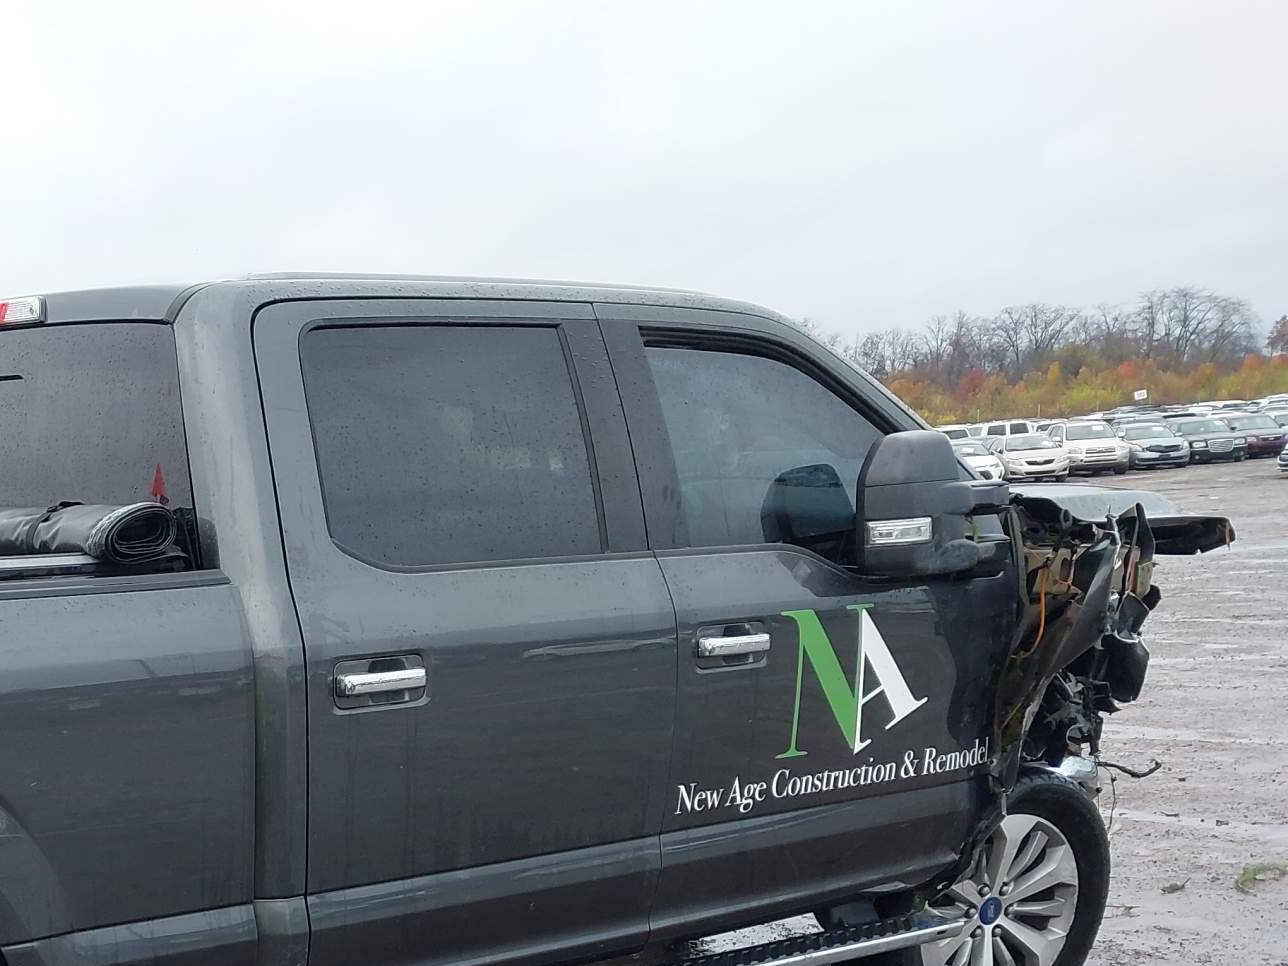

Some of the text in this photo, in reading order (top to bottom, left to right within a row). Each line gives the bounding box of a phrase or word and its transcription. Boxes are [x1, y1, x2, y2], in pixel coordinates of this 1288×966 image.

[776, 603, 929, 759] NA
[674, 783, 724, 814] New
[725, 777, 767, 812] Age
[772, 757, 896, 798] Construction
[900, 750, 920, 777] &
